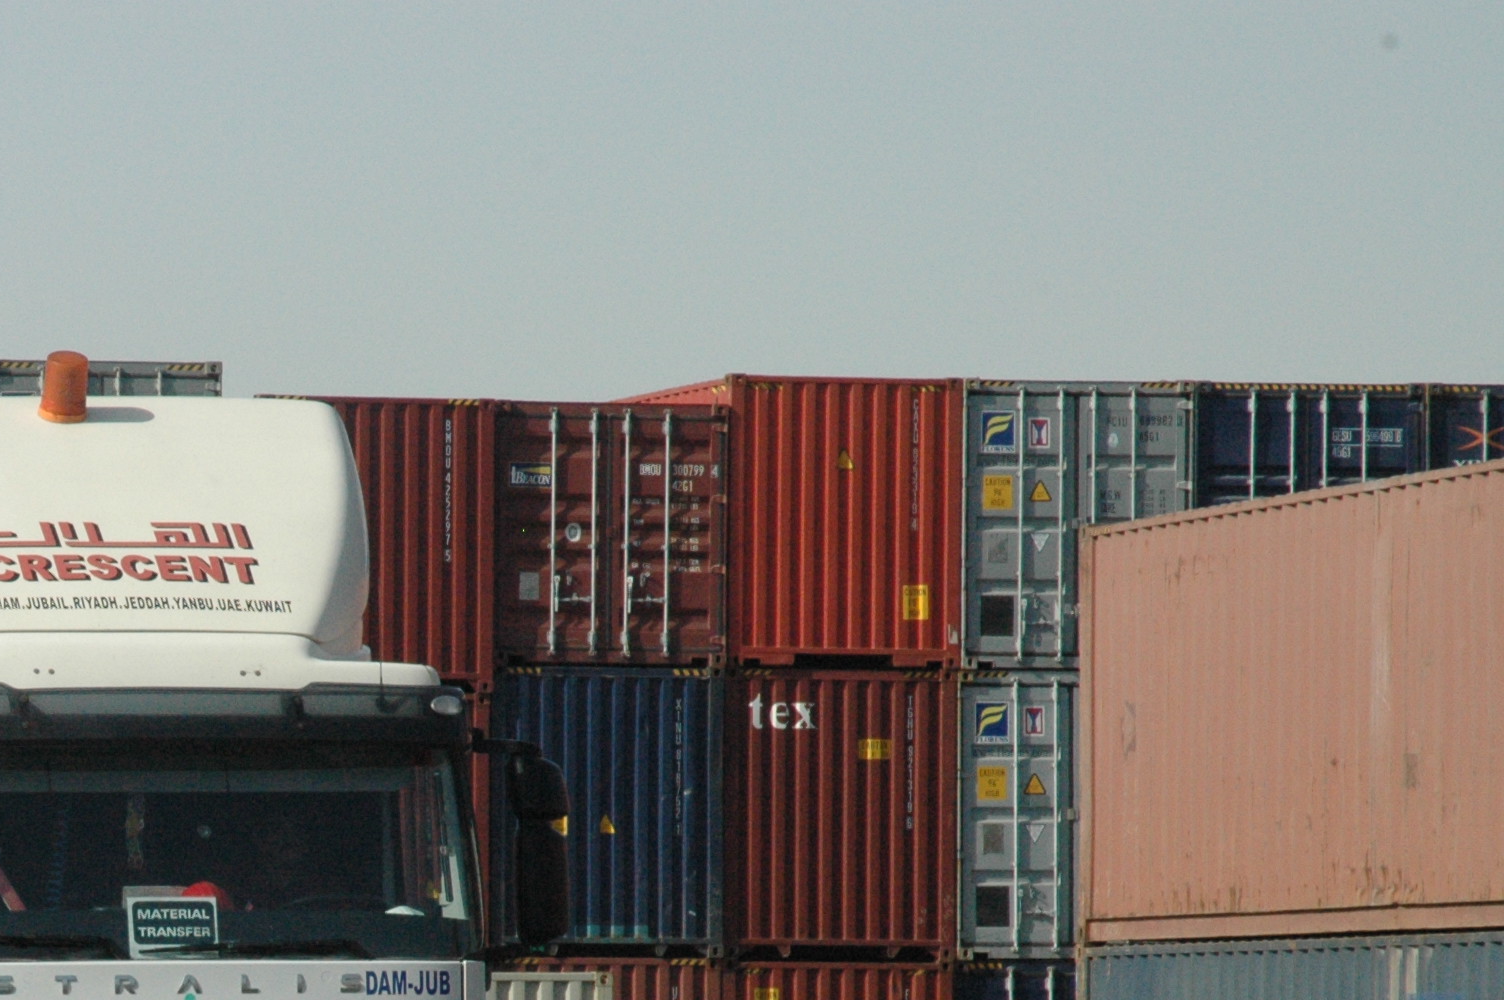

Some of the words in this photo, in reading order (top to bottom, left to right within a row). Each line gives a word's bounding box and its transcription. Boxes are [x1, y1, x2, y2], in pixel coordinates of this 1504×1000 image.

[748, 692, 817, 729] tex
[136, 907, 211, 921] MATERIAL
[138, 925, 212, 938] TRANSFER
[366, 970, 452, 996] DAM-JUB
